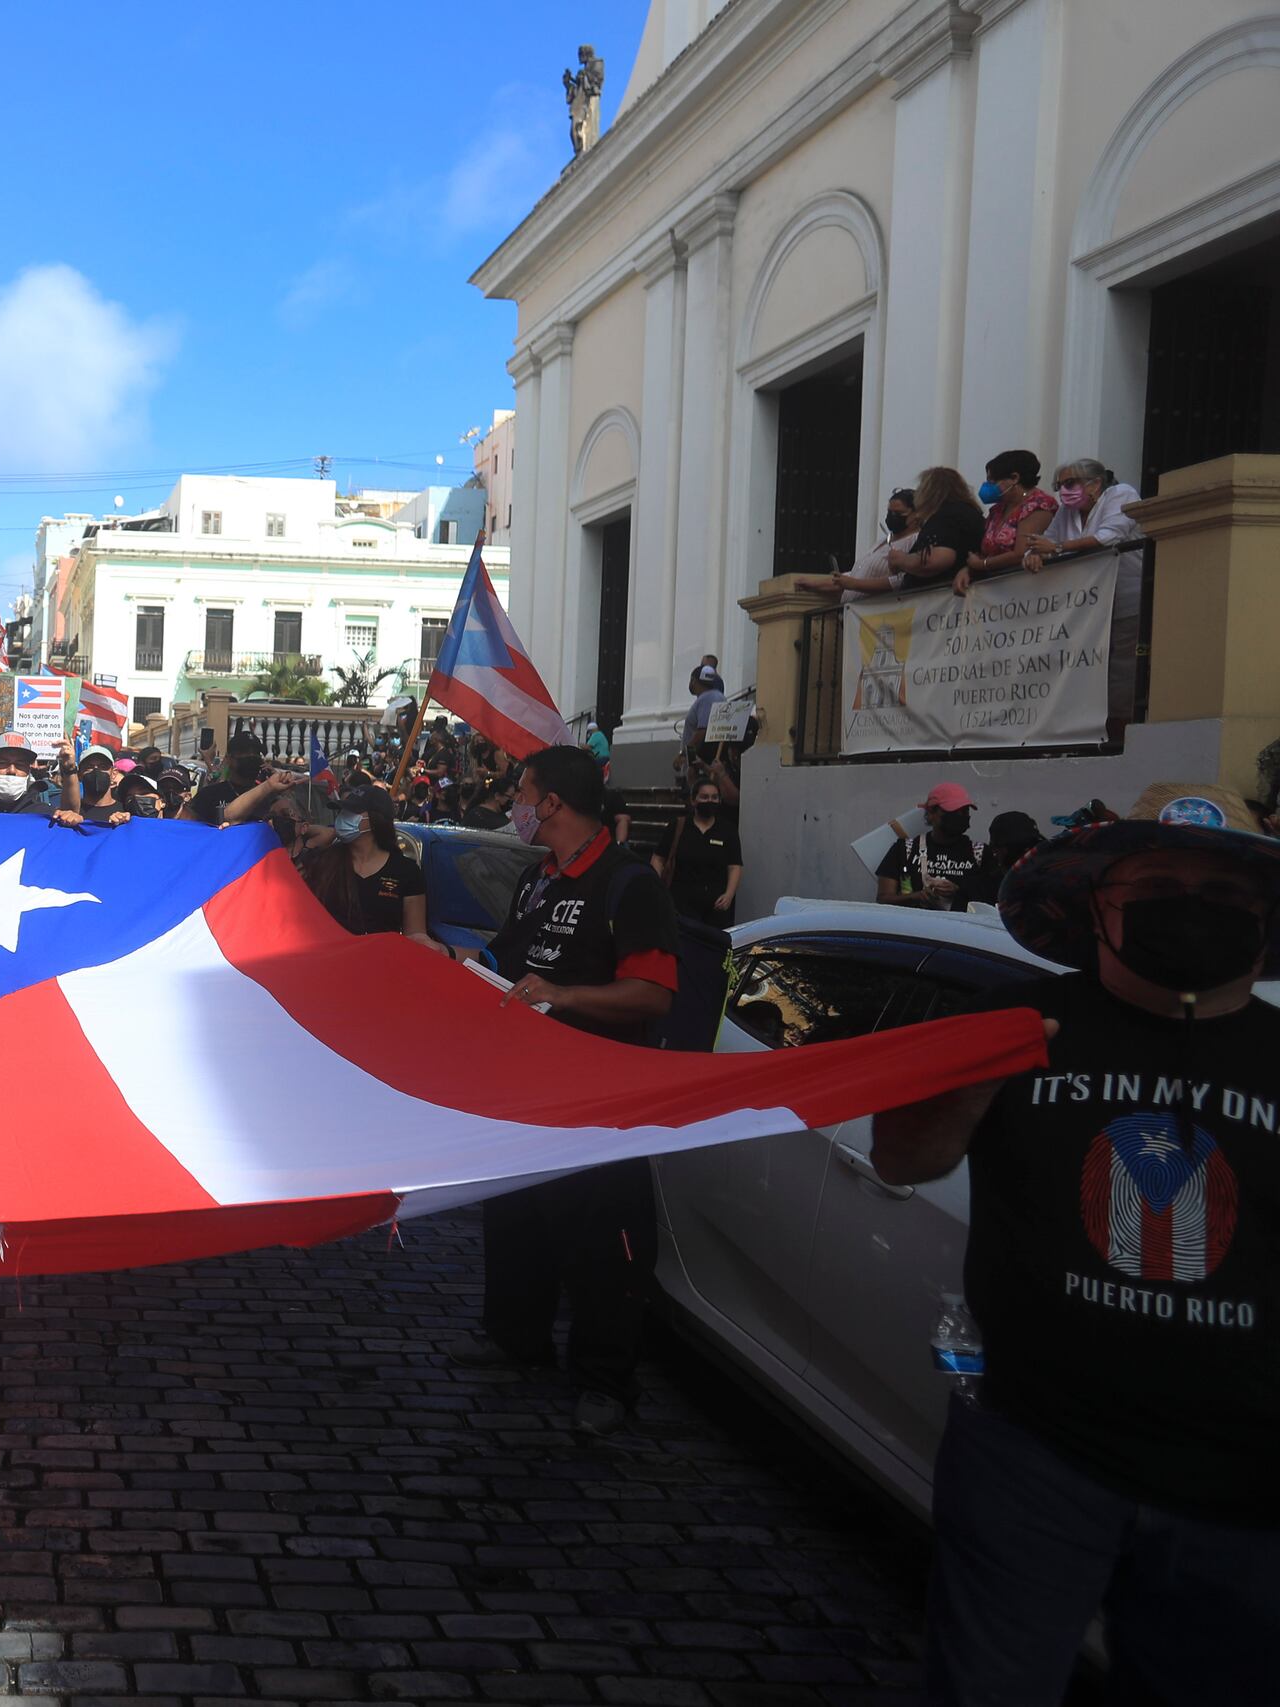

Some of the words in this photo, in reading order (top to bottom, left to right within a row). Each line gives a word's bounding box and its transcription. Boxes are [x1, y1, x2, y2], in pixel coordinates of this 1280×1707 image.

[1036, 595, 1061, 615] DE
[1066, 586, 1099, 609] LOS
[944, 635, 968, 657] 500
[971, 630, 1017, 652] AÑOS
[1022, 627, 1043, 646] DE
[1048, 623, 1070, 641] LA
[992, 659, 1012, 678] DE
[32, 713, 59, 721] quitaron
[959, 707, 1038, 729] (1521-2021)
[552, 899, 585, 925] CTE
[1031, 1073, 1091, 1104] IT'S
[1103, 1073, 1141, 1101] IN
[1152, 1076, 1210, 1110] MY
[1222, 1088, 1280, 1134] DN
[1065, 1271, 1173, 1318] PUERTO
[1186, 1298, 1254, 1328] RICO
